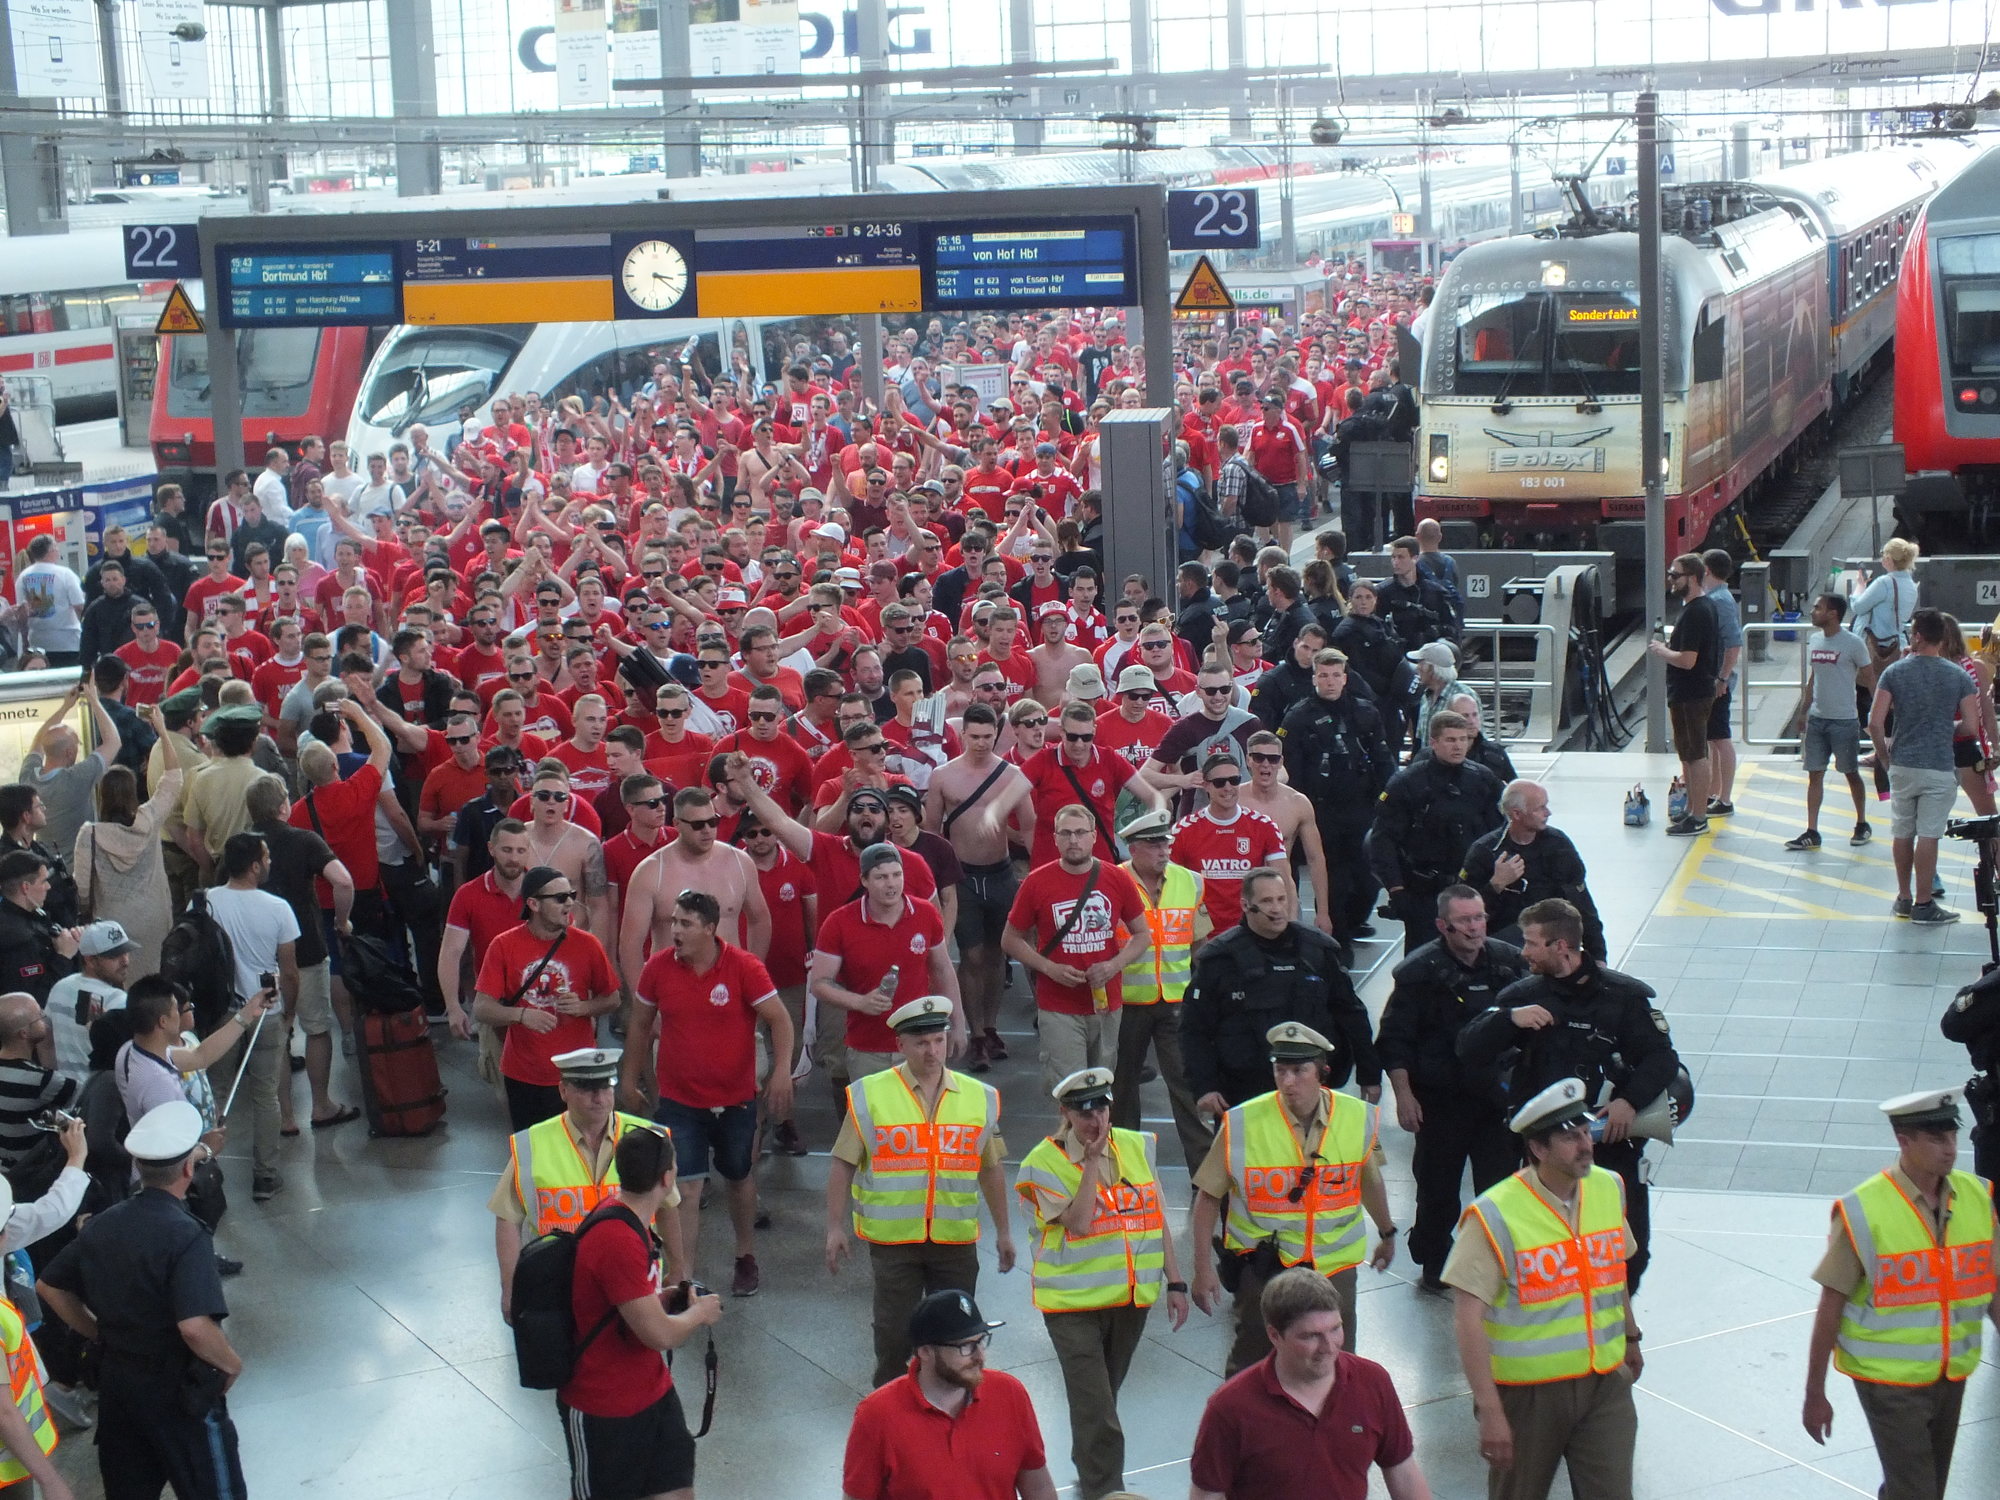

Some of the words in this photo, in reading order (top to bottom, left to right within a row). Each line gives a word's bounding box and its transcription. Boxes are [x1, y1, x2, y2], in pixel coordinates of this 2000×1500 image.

[1609, 159, 1620, 172] A
[1661, 156, 1672, 170] A
[1193, 191, 1248, 236] 23
[866, 223, 902, 238] 24-36
[937, 235, 961, 245] 15:16
[131, 226, 178, 267] 22
[416, 240, 441, 253] 5-21
[973, 252, 992, 260] von
[997, 249, 1015, 260] Hof
[1020, 248, 1038, 259] Hbf
[262, 271, 308, 282] Dortmund
[312, 270, 328, 281] Hbf
[937, 278, 956, 286] 15:21
[974, 277, 984, 285] ICE
[1026, 276, 1048, 284] Essen
[1052, 275, 1064, 283] Hbf
[974, 288, 985, 296] ICE
[1010, 286, 1045, 295] Dortmund
[1049, 286, 1062, 294] Hbf
[1569, 308, 1638, 320] Sonderfahrt
[1522, 450, 1592, 470] alex
[1519, 477, 1540, 487] 183
[1544, 477, 1565, 487] 001
[1436, 503, 1480, 512] SIEMENS
[1472, 579, 1485, 592] 23
[1982, 585, 1997, 599] 24
[1201, 859, 1251, 870] VATRO
